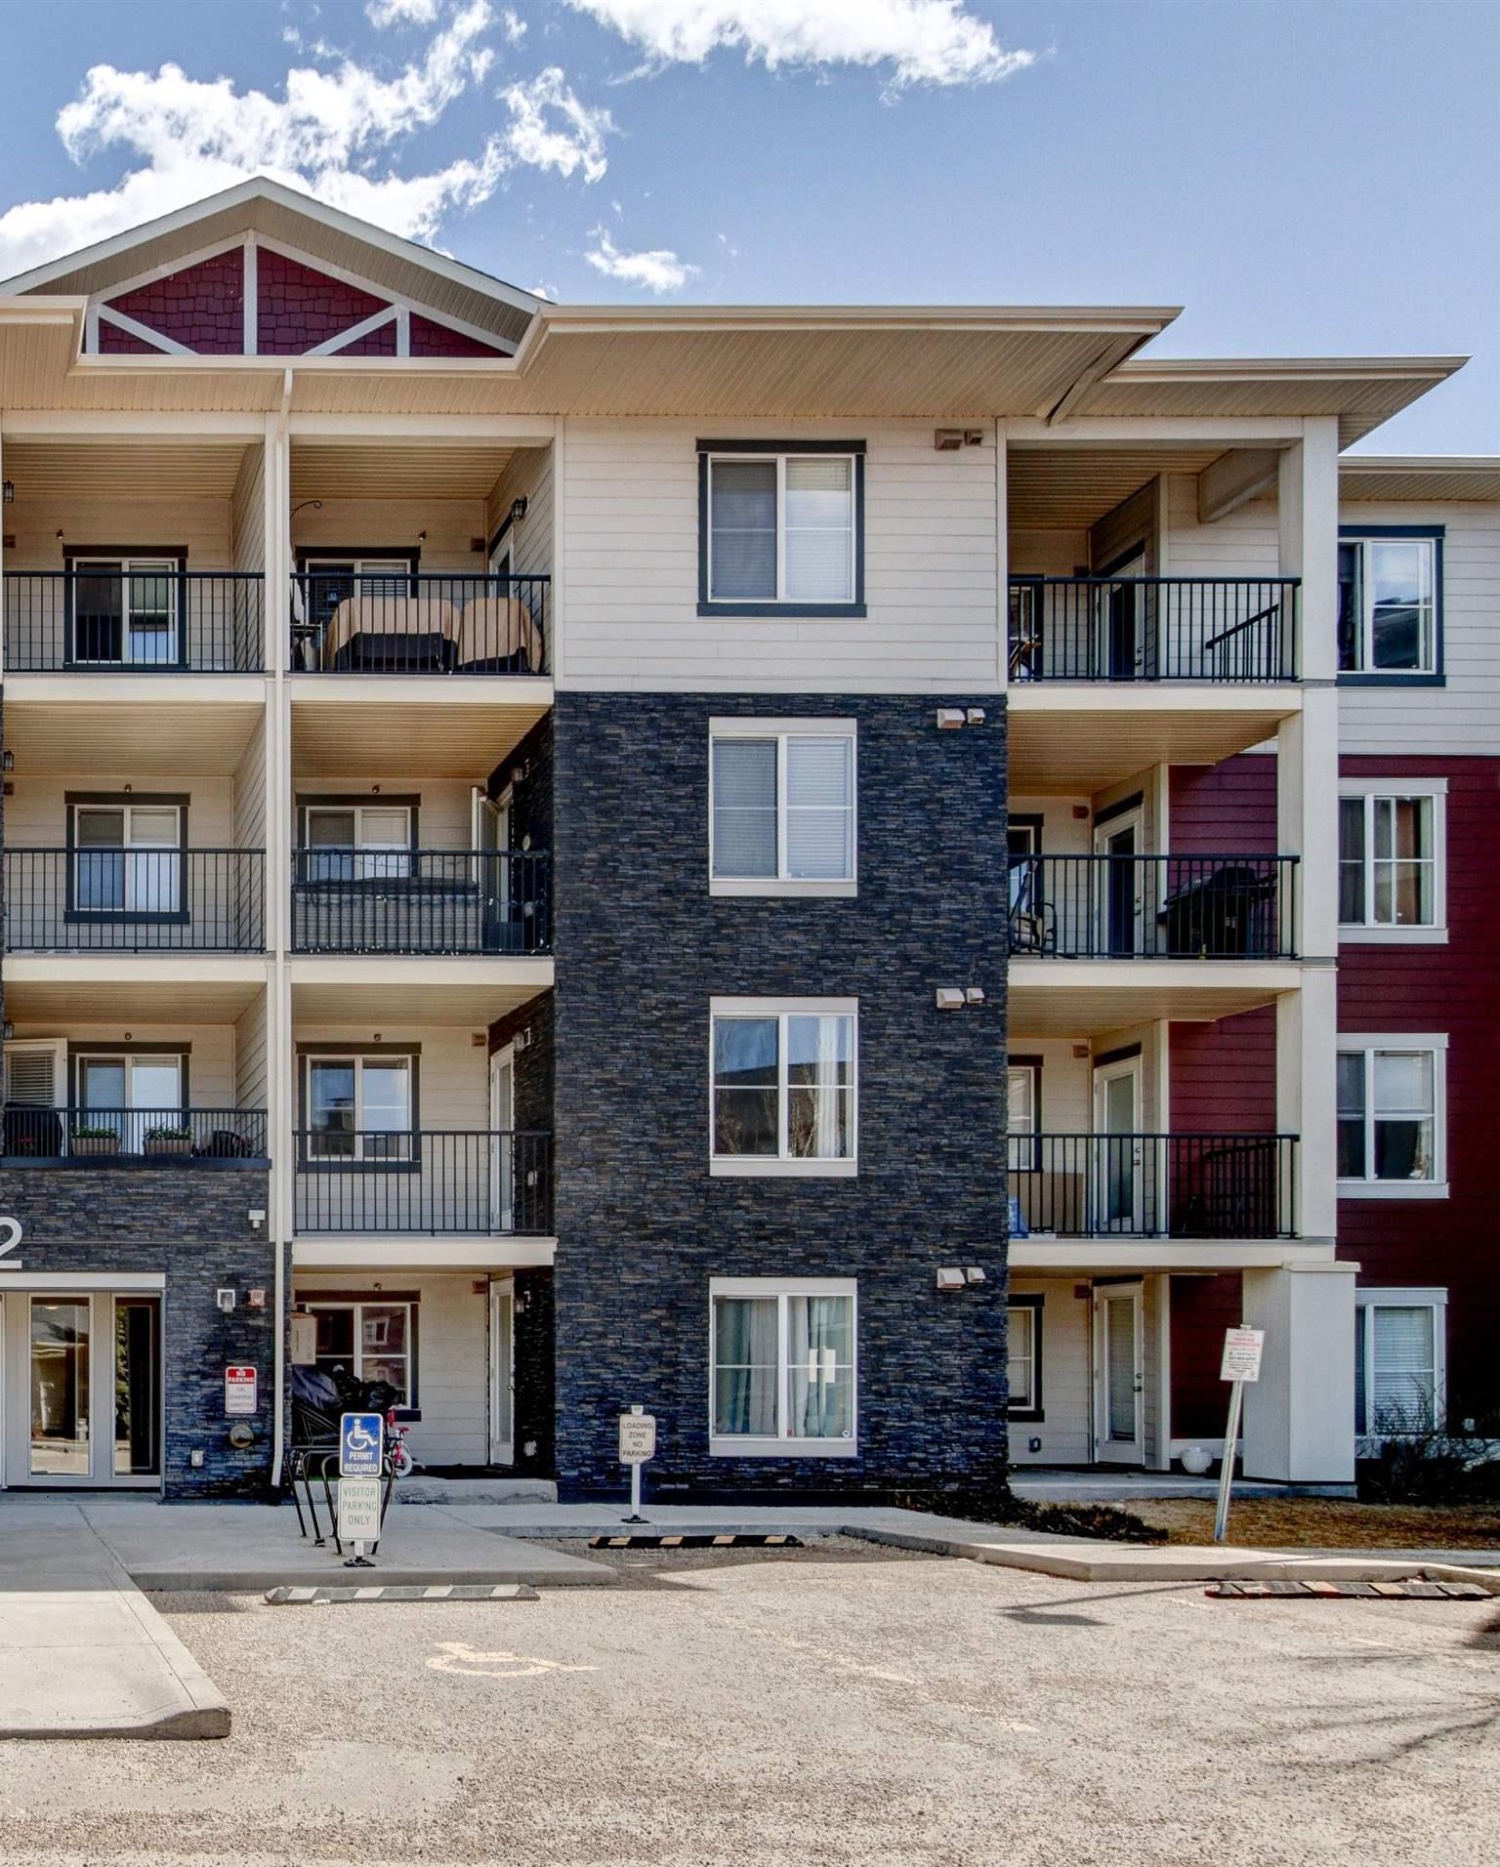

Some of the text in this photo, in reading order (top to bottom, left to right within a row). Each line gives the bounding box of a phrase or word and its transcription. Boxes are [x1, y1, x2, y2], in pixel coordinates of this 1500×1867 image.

[628, 1431, 647, 1439] ZONE
[349, 1452, 373, 1460] PERMIT
[344, 1463, 378, 1472] REQUIRED
[342, 1487, 376, 1497] VISITOR
[342, 1501, 377, 1511] PARKING
[347, 1515, 371, 1525] ONLY
